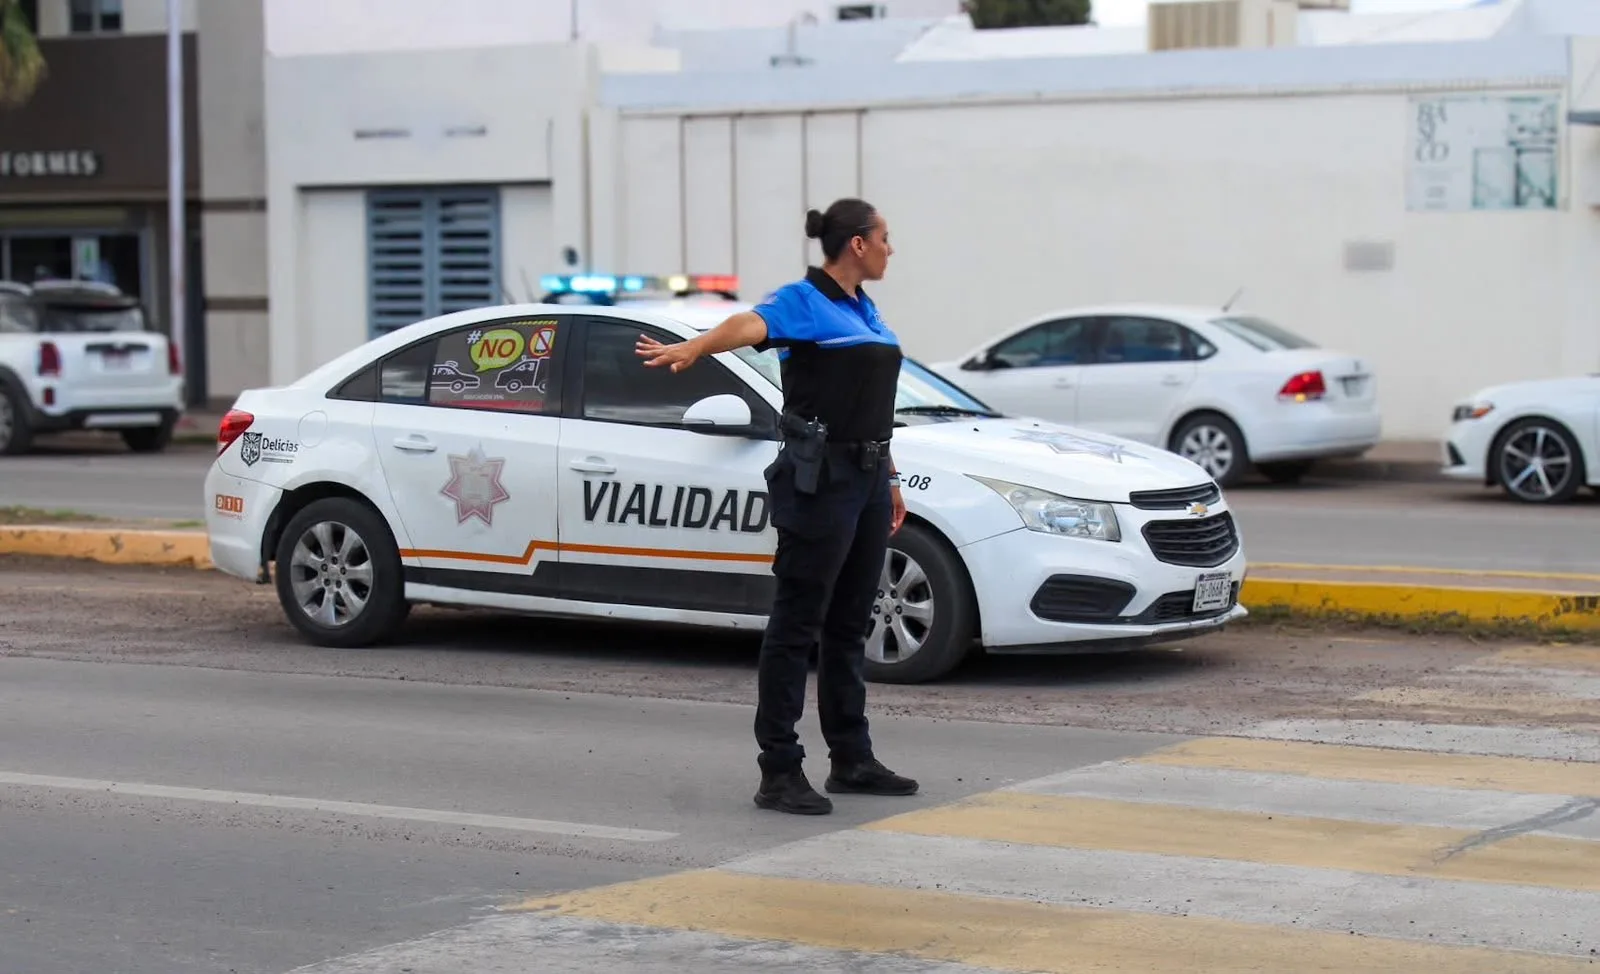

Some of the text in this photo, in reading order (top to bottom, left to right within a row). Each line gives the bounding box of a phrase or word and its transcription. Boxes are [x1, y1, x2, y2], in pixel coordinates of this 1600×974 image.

[261, 437, 299, 452] Delicias
[216, 496, 242, 512] 911
[583, 480, 769, 533] VIALIDAD
